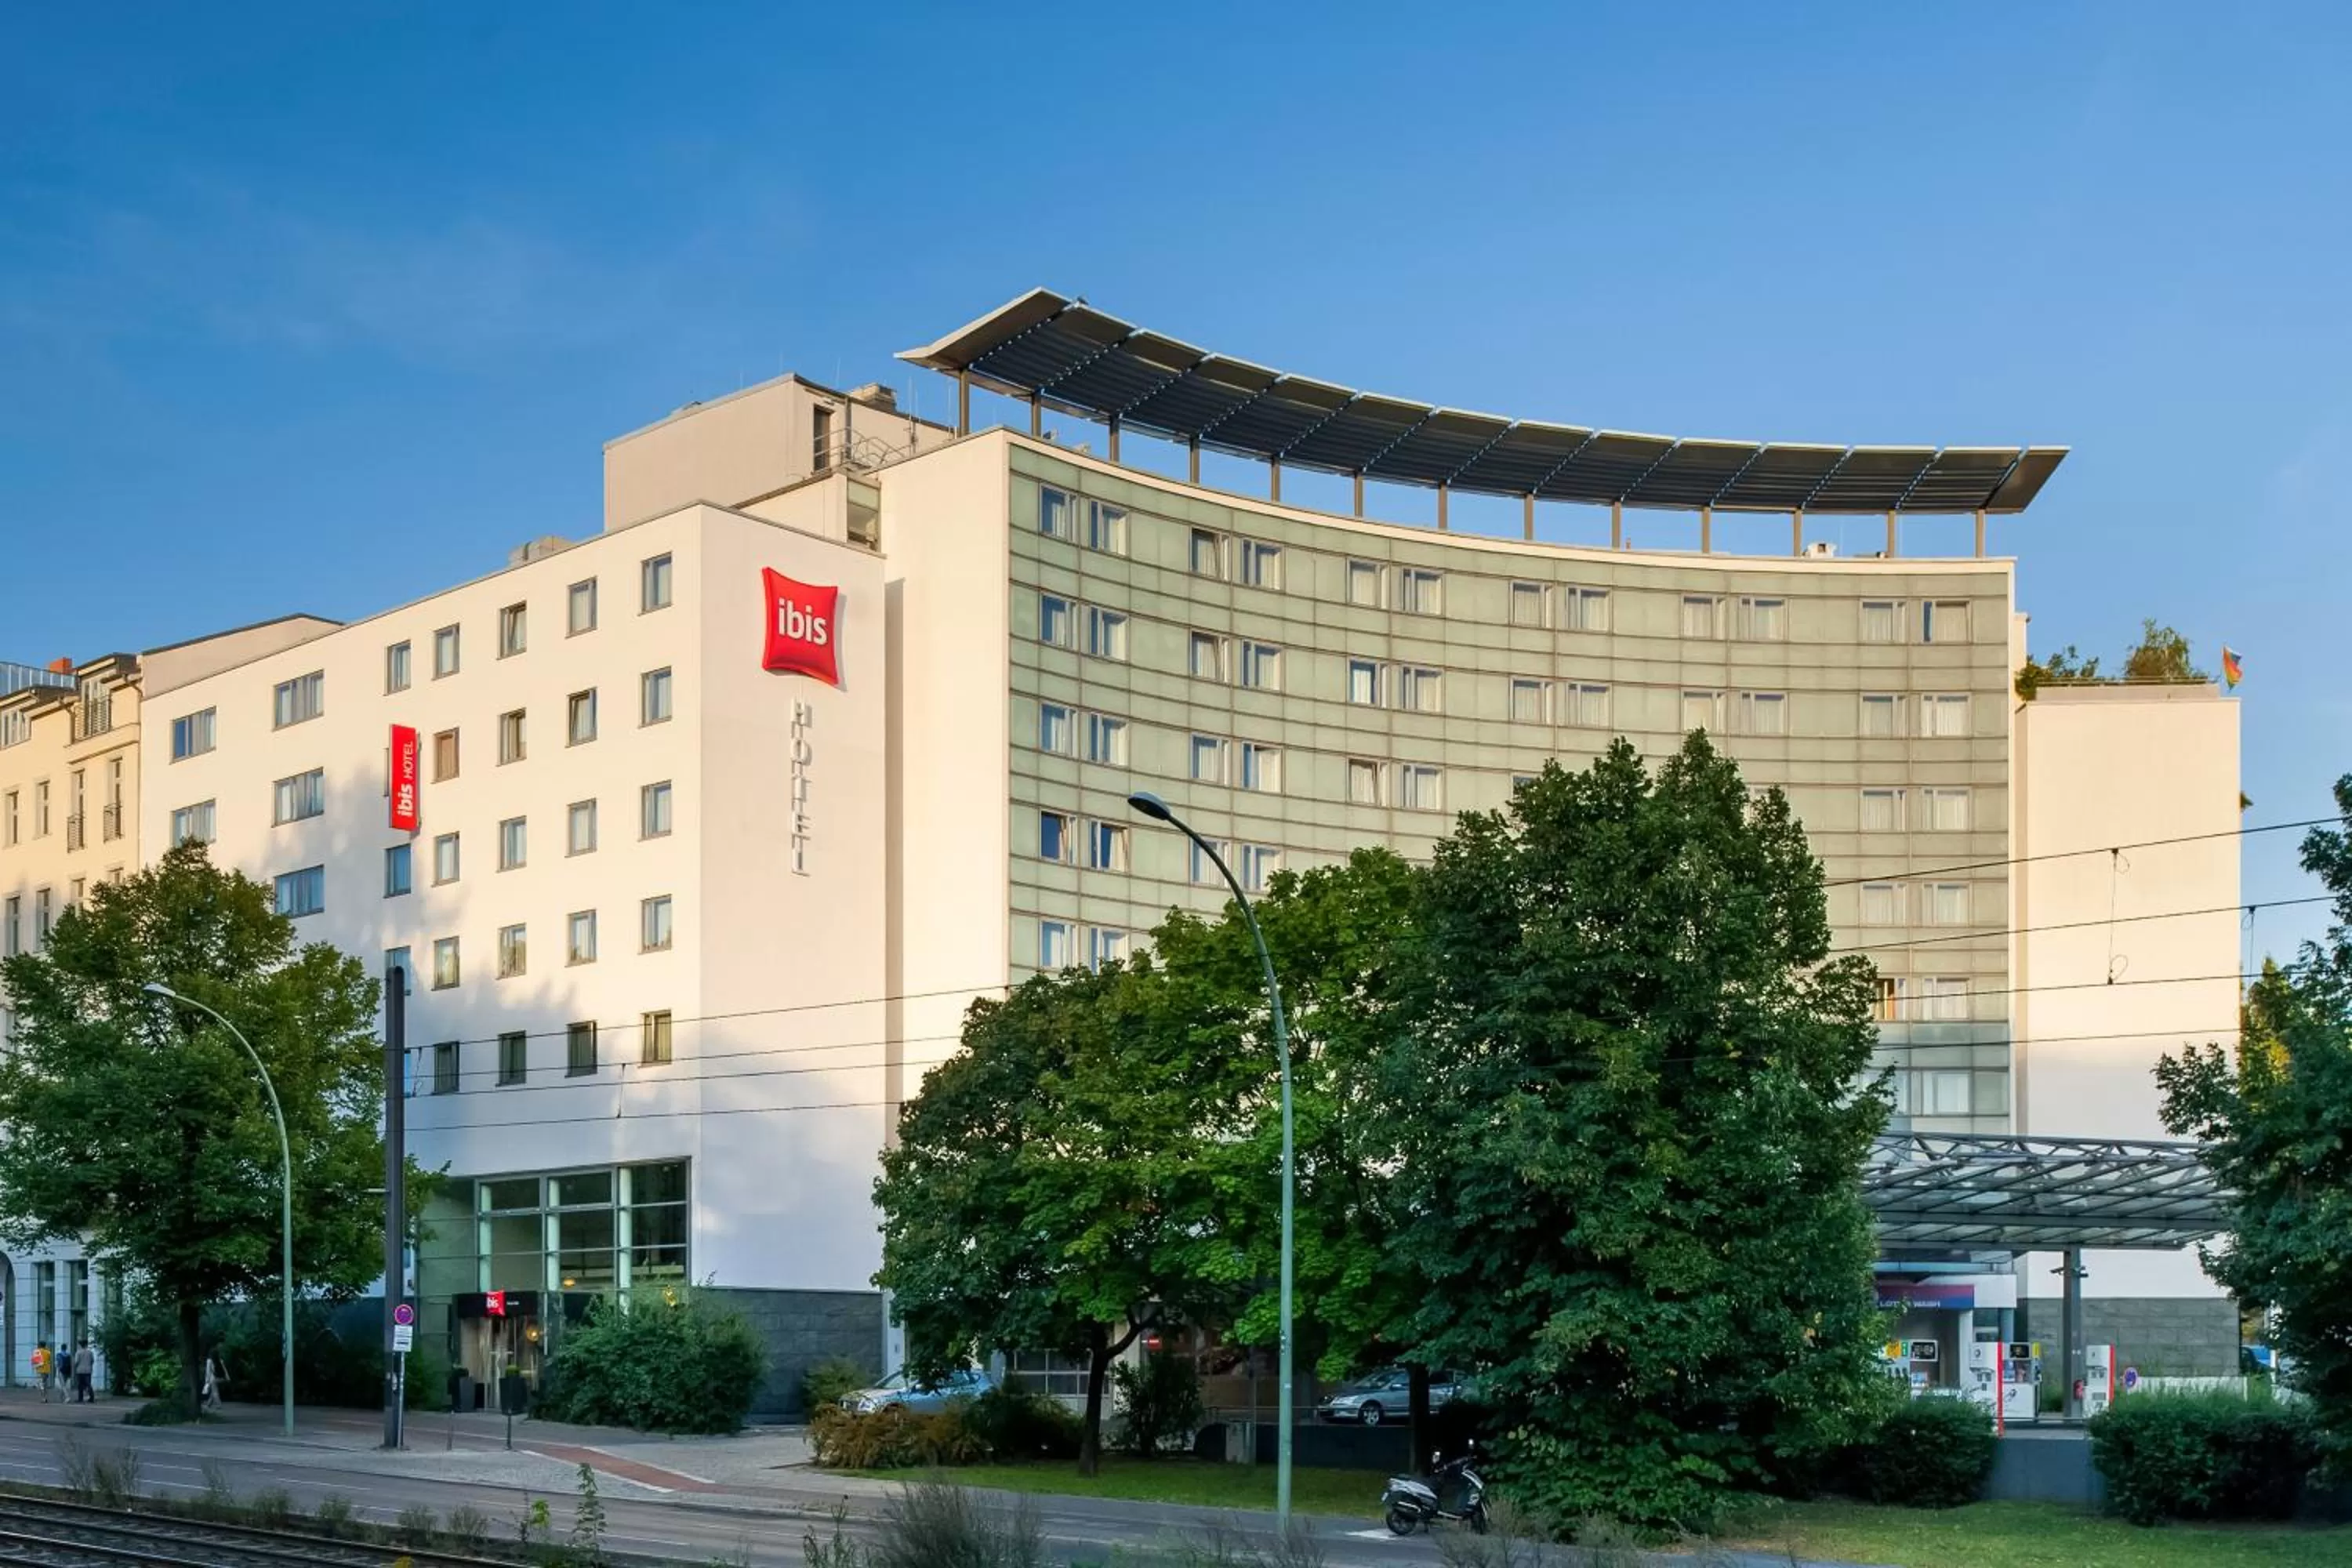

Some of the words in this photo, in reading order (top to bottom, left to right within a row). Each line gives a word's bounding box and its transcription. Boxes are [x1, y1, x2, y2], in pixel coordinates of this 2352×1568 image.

[778, 597, 828, 646] ibis
[402, 740, 414, 779] HOTEL
[397, 782, 414, 817] ibis
[789, 697, 811, 877] HOTEL
